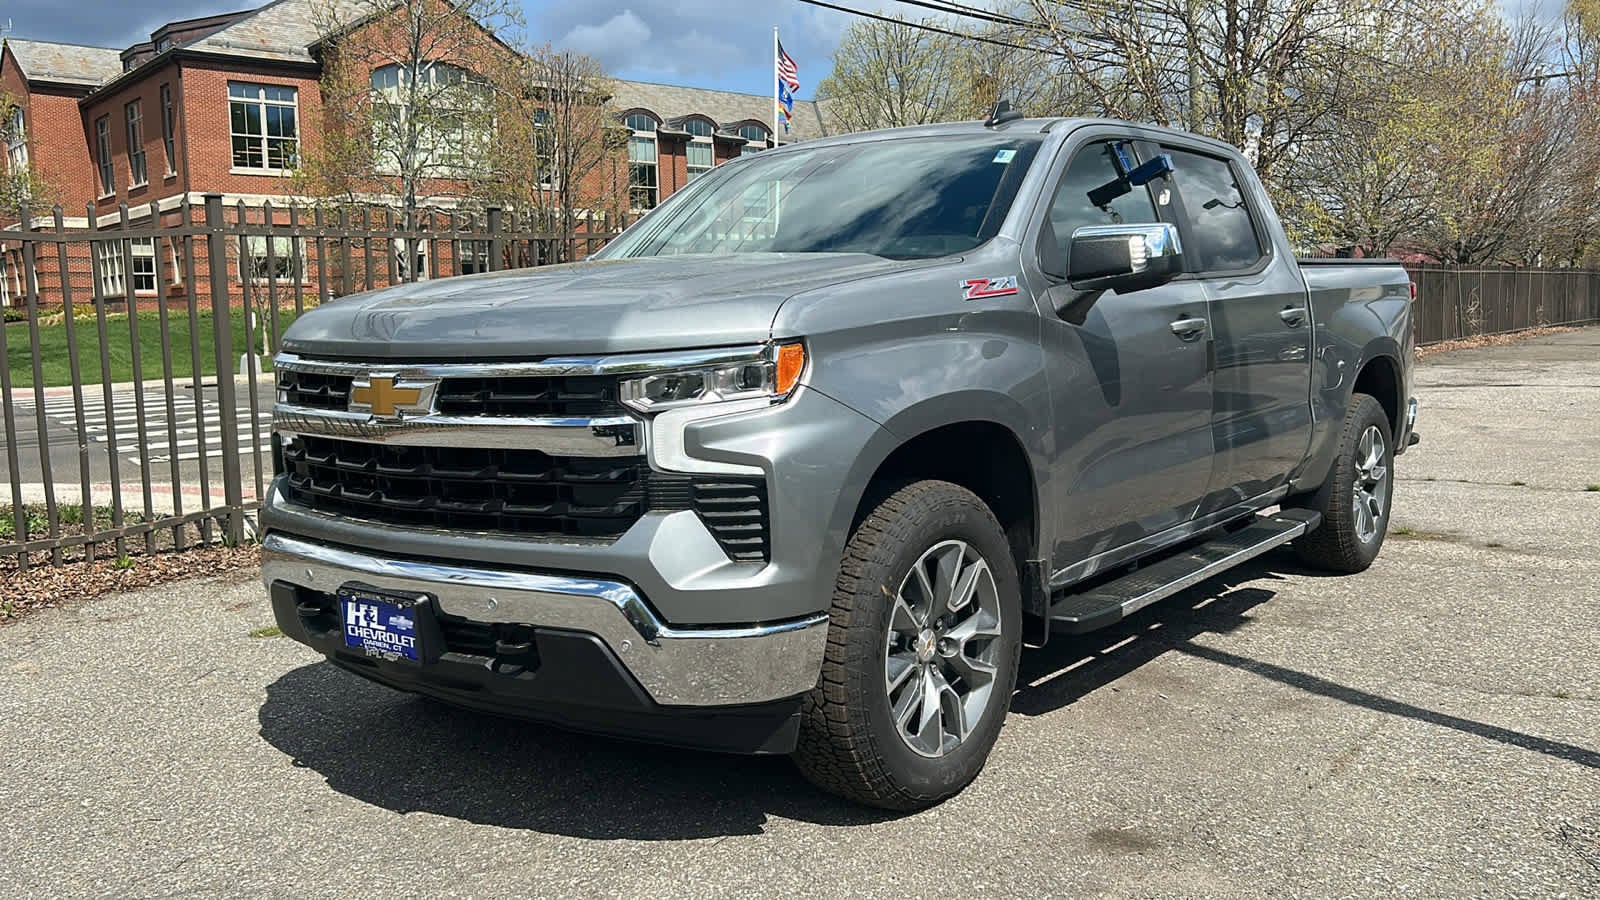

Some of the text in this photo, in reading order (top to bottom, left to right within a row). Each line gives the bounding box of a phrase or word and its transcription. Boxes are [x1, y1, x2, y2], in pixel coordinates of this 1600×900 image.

[960, 275, 1019, 300] Z71
[347, 602, 386, 630] H&L
[348, 625, 416, 647] CHEVROLET
